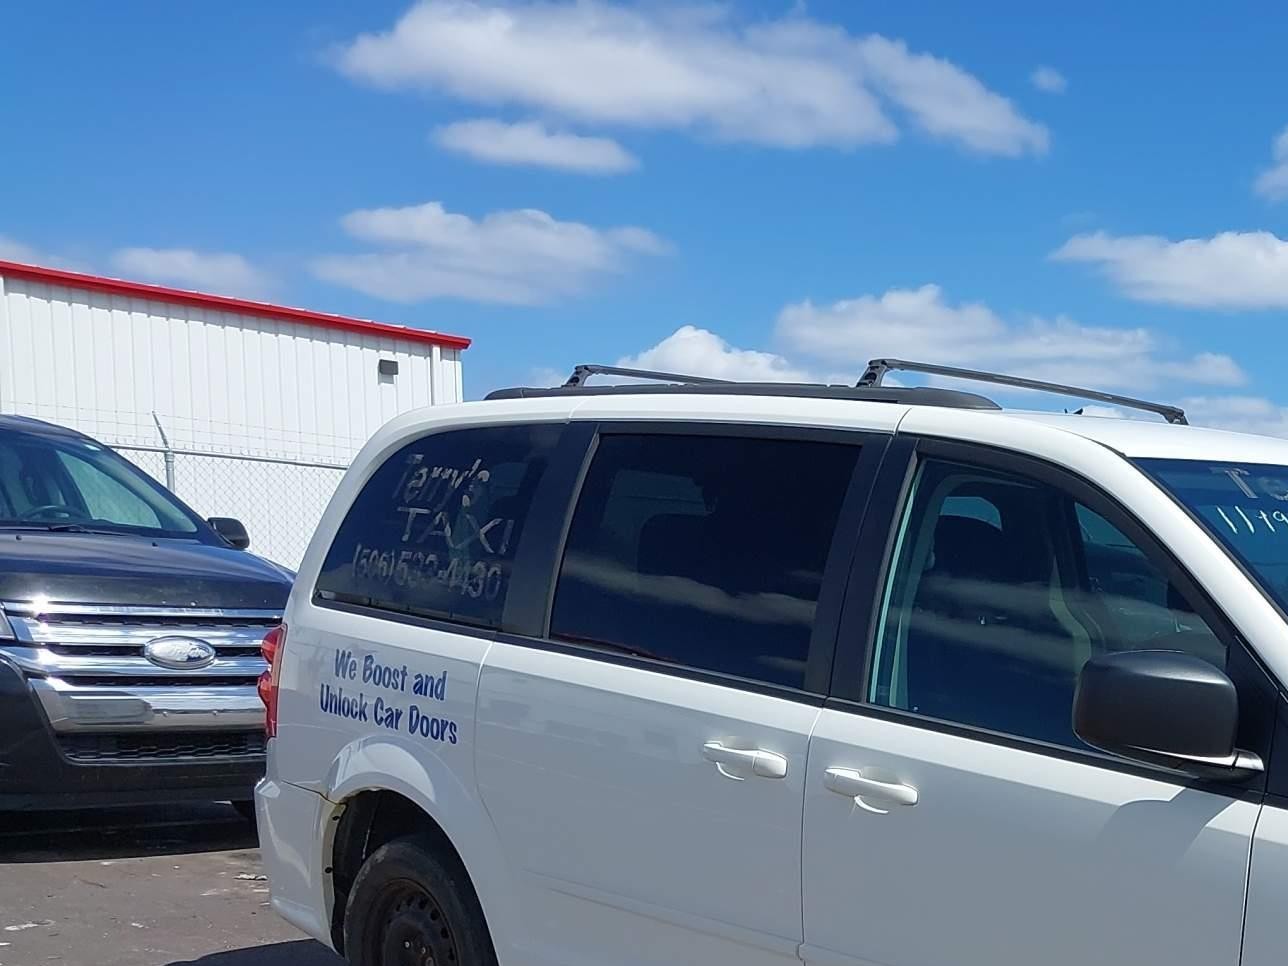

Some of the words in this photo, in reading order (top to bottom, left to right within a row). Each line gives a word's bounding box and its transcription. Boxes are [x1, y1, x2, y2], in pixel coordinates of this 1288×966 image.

[397, 506, 515, 556] TAXI
[334, 648, 358, 681] We
[362, 654, 408, 692] Boost
[412, 670, 448, 702] and
[320, 682, 368, 723] Unlock
[373, 696, 404, 731] Car
[408, 704, 458, 745] Doors
